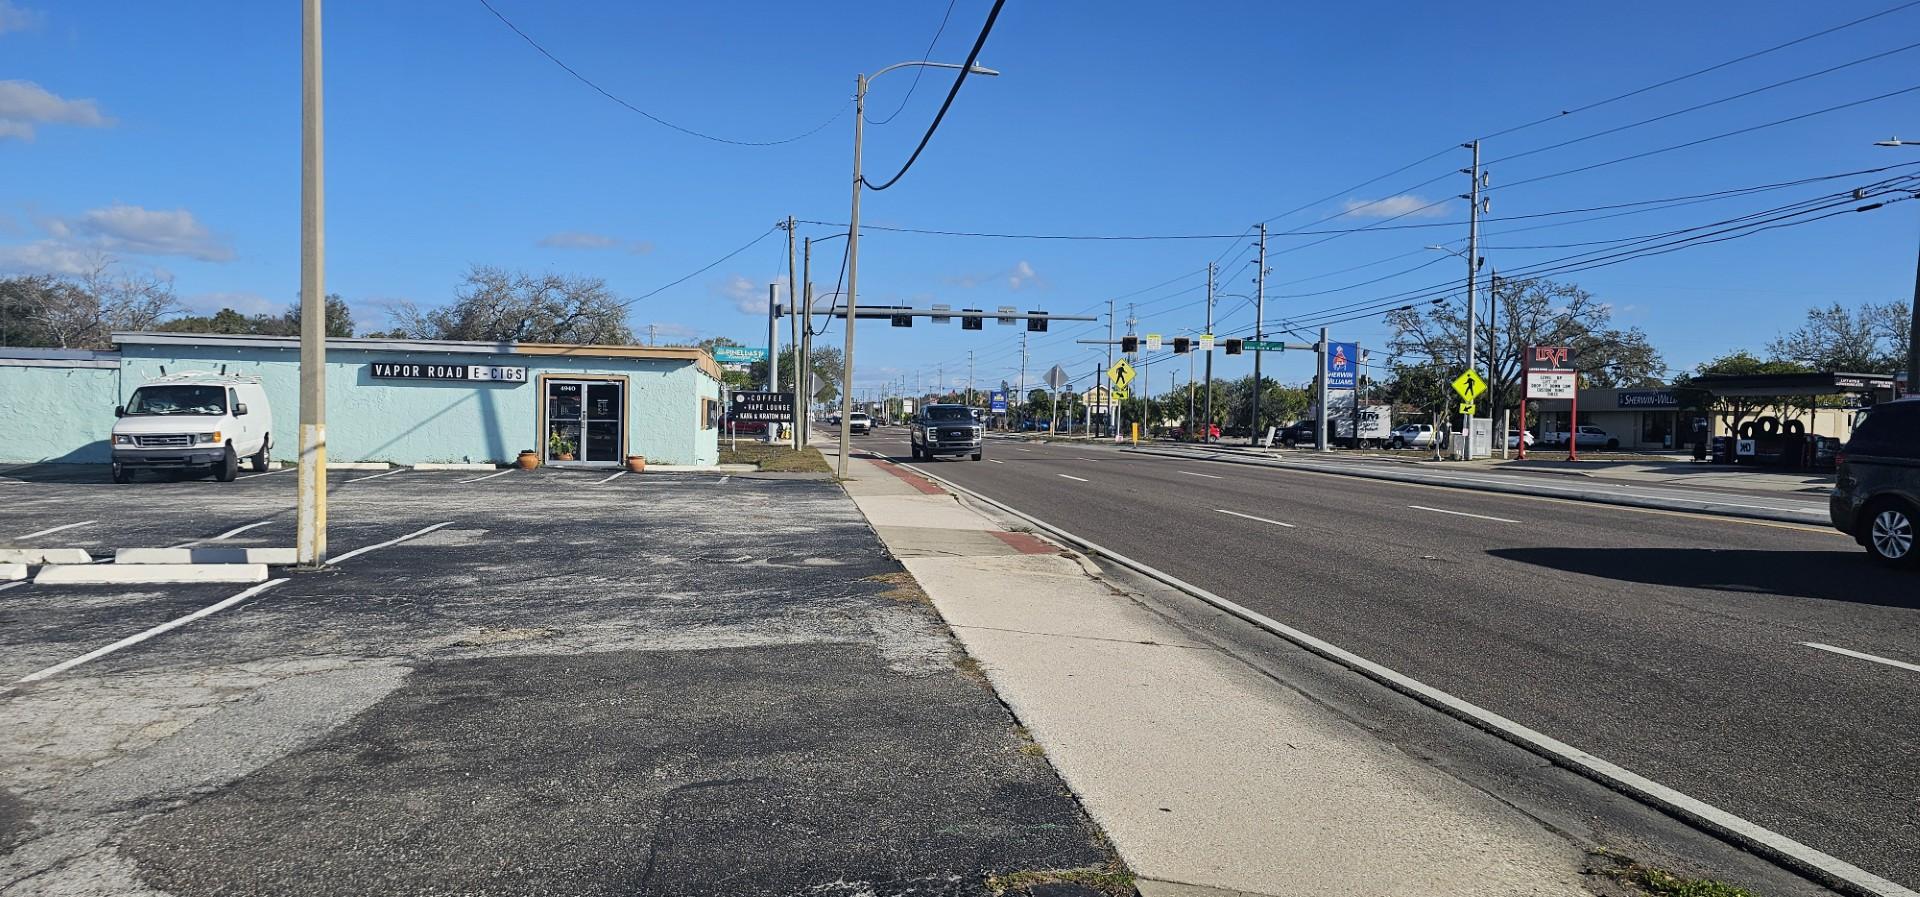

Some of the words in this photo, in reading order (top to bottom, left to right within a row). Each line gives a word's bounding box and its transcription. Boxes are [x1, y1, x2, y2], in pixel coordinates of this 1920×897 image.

[375, 364, 420, 377] VAPOR
[428, 365, 463, 378] ROAD
[473, 367, 522, 380] E-CIGS
